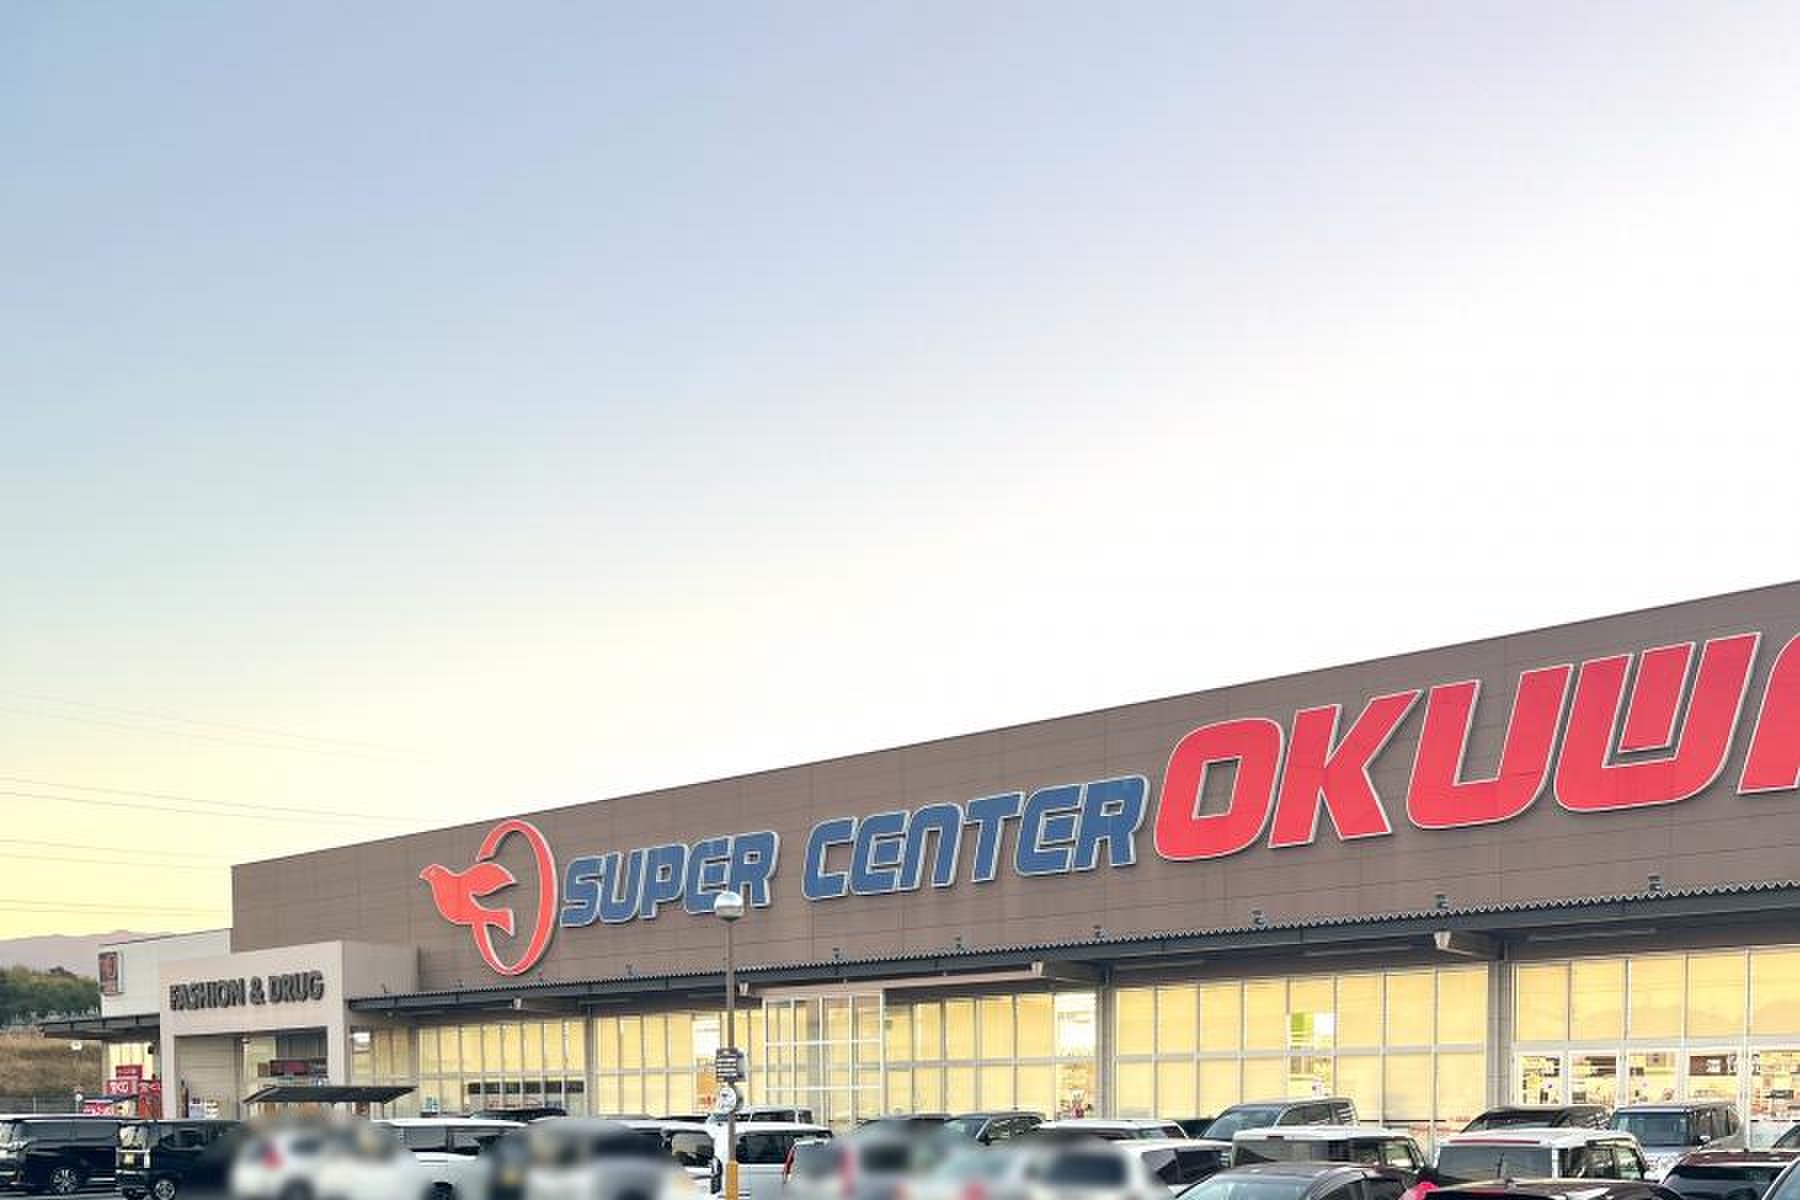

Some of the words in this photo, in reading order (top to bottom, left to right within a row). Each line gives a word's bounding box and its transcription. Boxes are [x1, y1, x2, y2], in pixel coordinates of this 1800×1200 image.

[560, 830, 778, 928] SUPER
[801, 774, 1150, 901] CENTER
[169, 978, 246, 1010] FASHION
[250, 976, 266, 1005] &
[267, 970, 325, 1003] DRUG
